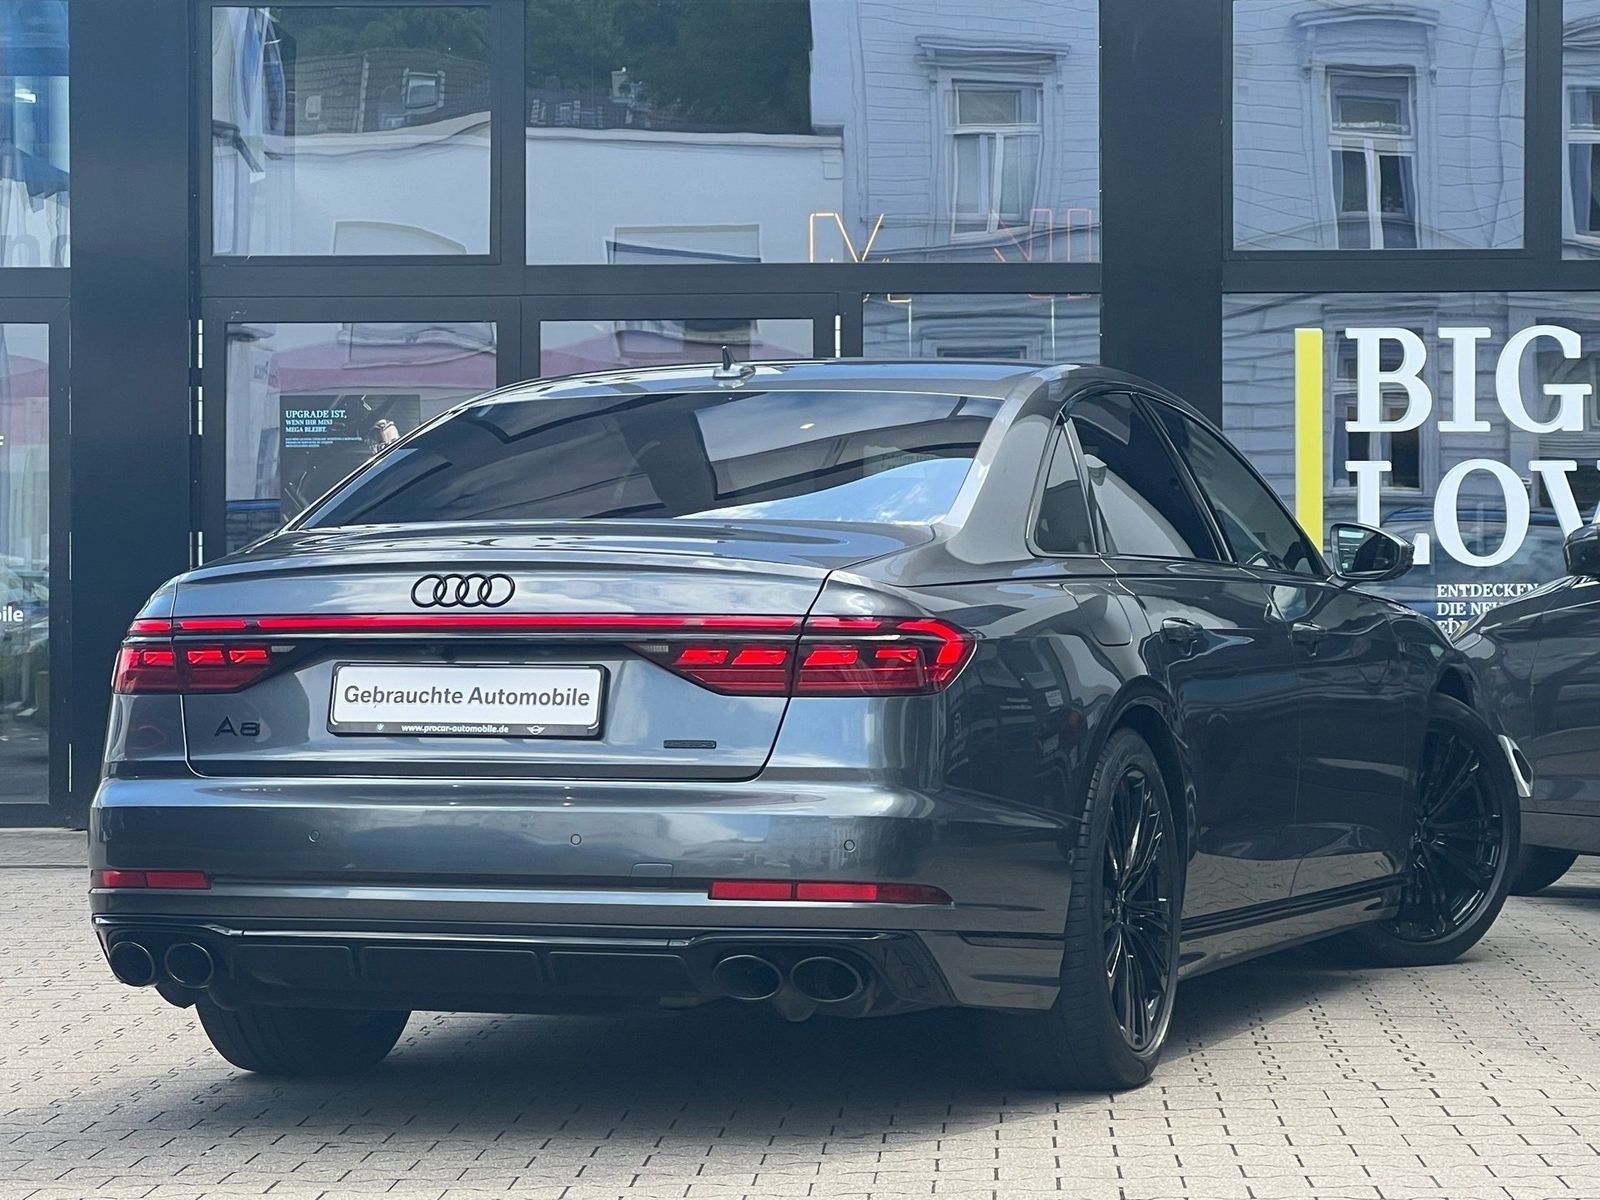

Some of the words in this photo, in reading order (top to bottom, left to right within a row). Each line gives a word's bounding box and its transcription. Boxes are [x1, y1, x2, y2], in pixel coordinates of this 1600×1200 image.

[1345, 325, 1592, 433] BIG
[285, 410, 329, 418] UPGRADE
[0, 605, 24, 622] ile
[1436, 602, 1466, 616] DIE
[344, 685, 463, 705] Gebrauchte
[467, 686, 590, 707] Automobile
[214, 715, 261, 737] A8
[401, 724, 510, 734] www.procar-automobile.de
